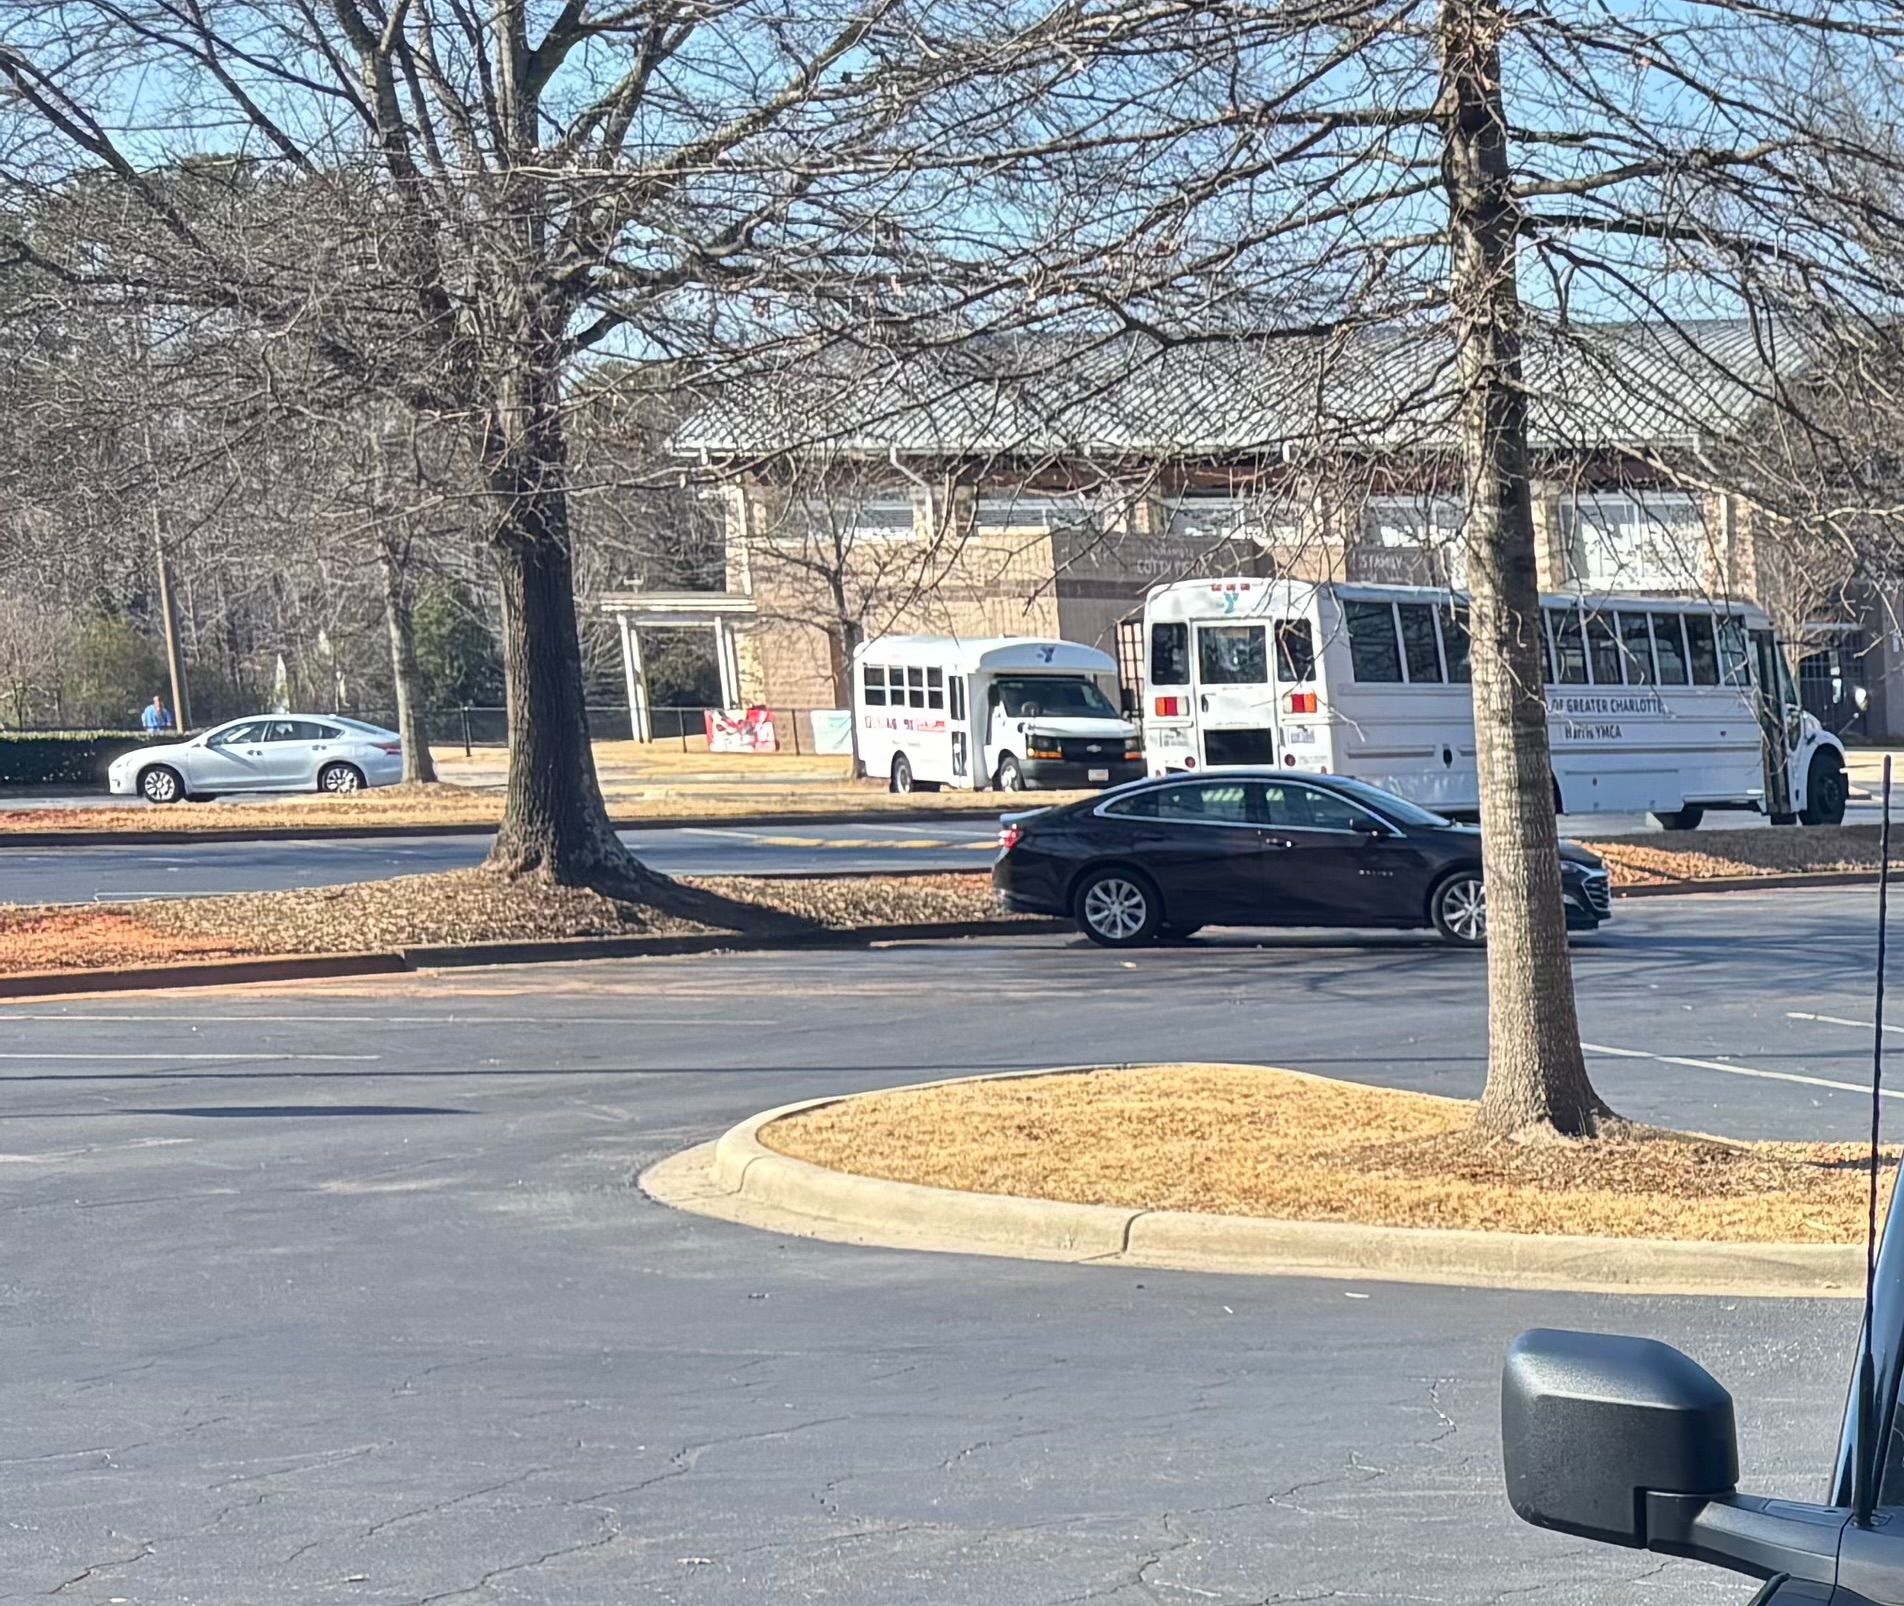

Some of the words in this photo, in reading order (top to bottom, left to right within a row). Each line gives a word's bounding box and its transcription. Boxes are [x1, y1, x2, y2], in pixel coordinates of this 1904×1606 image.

[1566, 698, 1608, 714] GREATER
[1610, 698, 1664, 714] CHARLOTTE
[1595, 724, 1622, 740] YMCA
